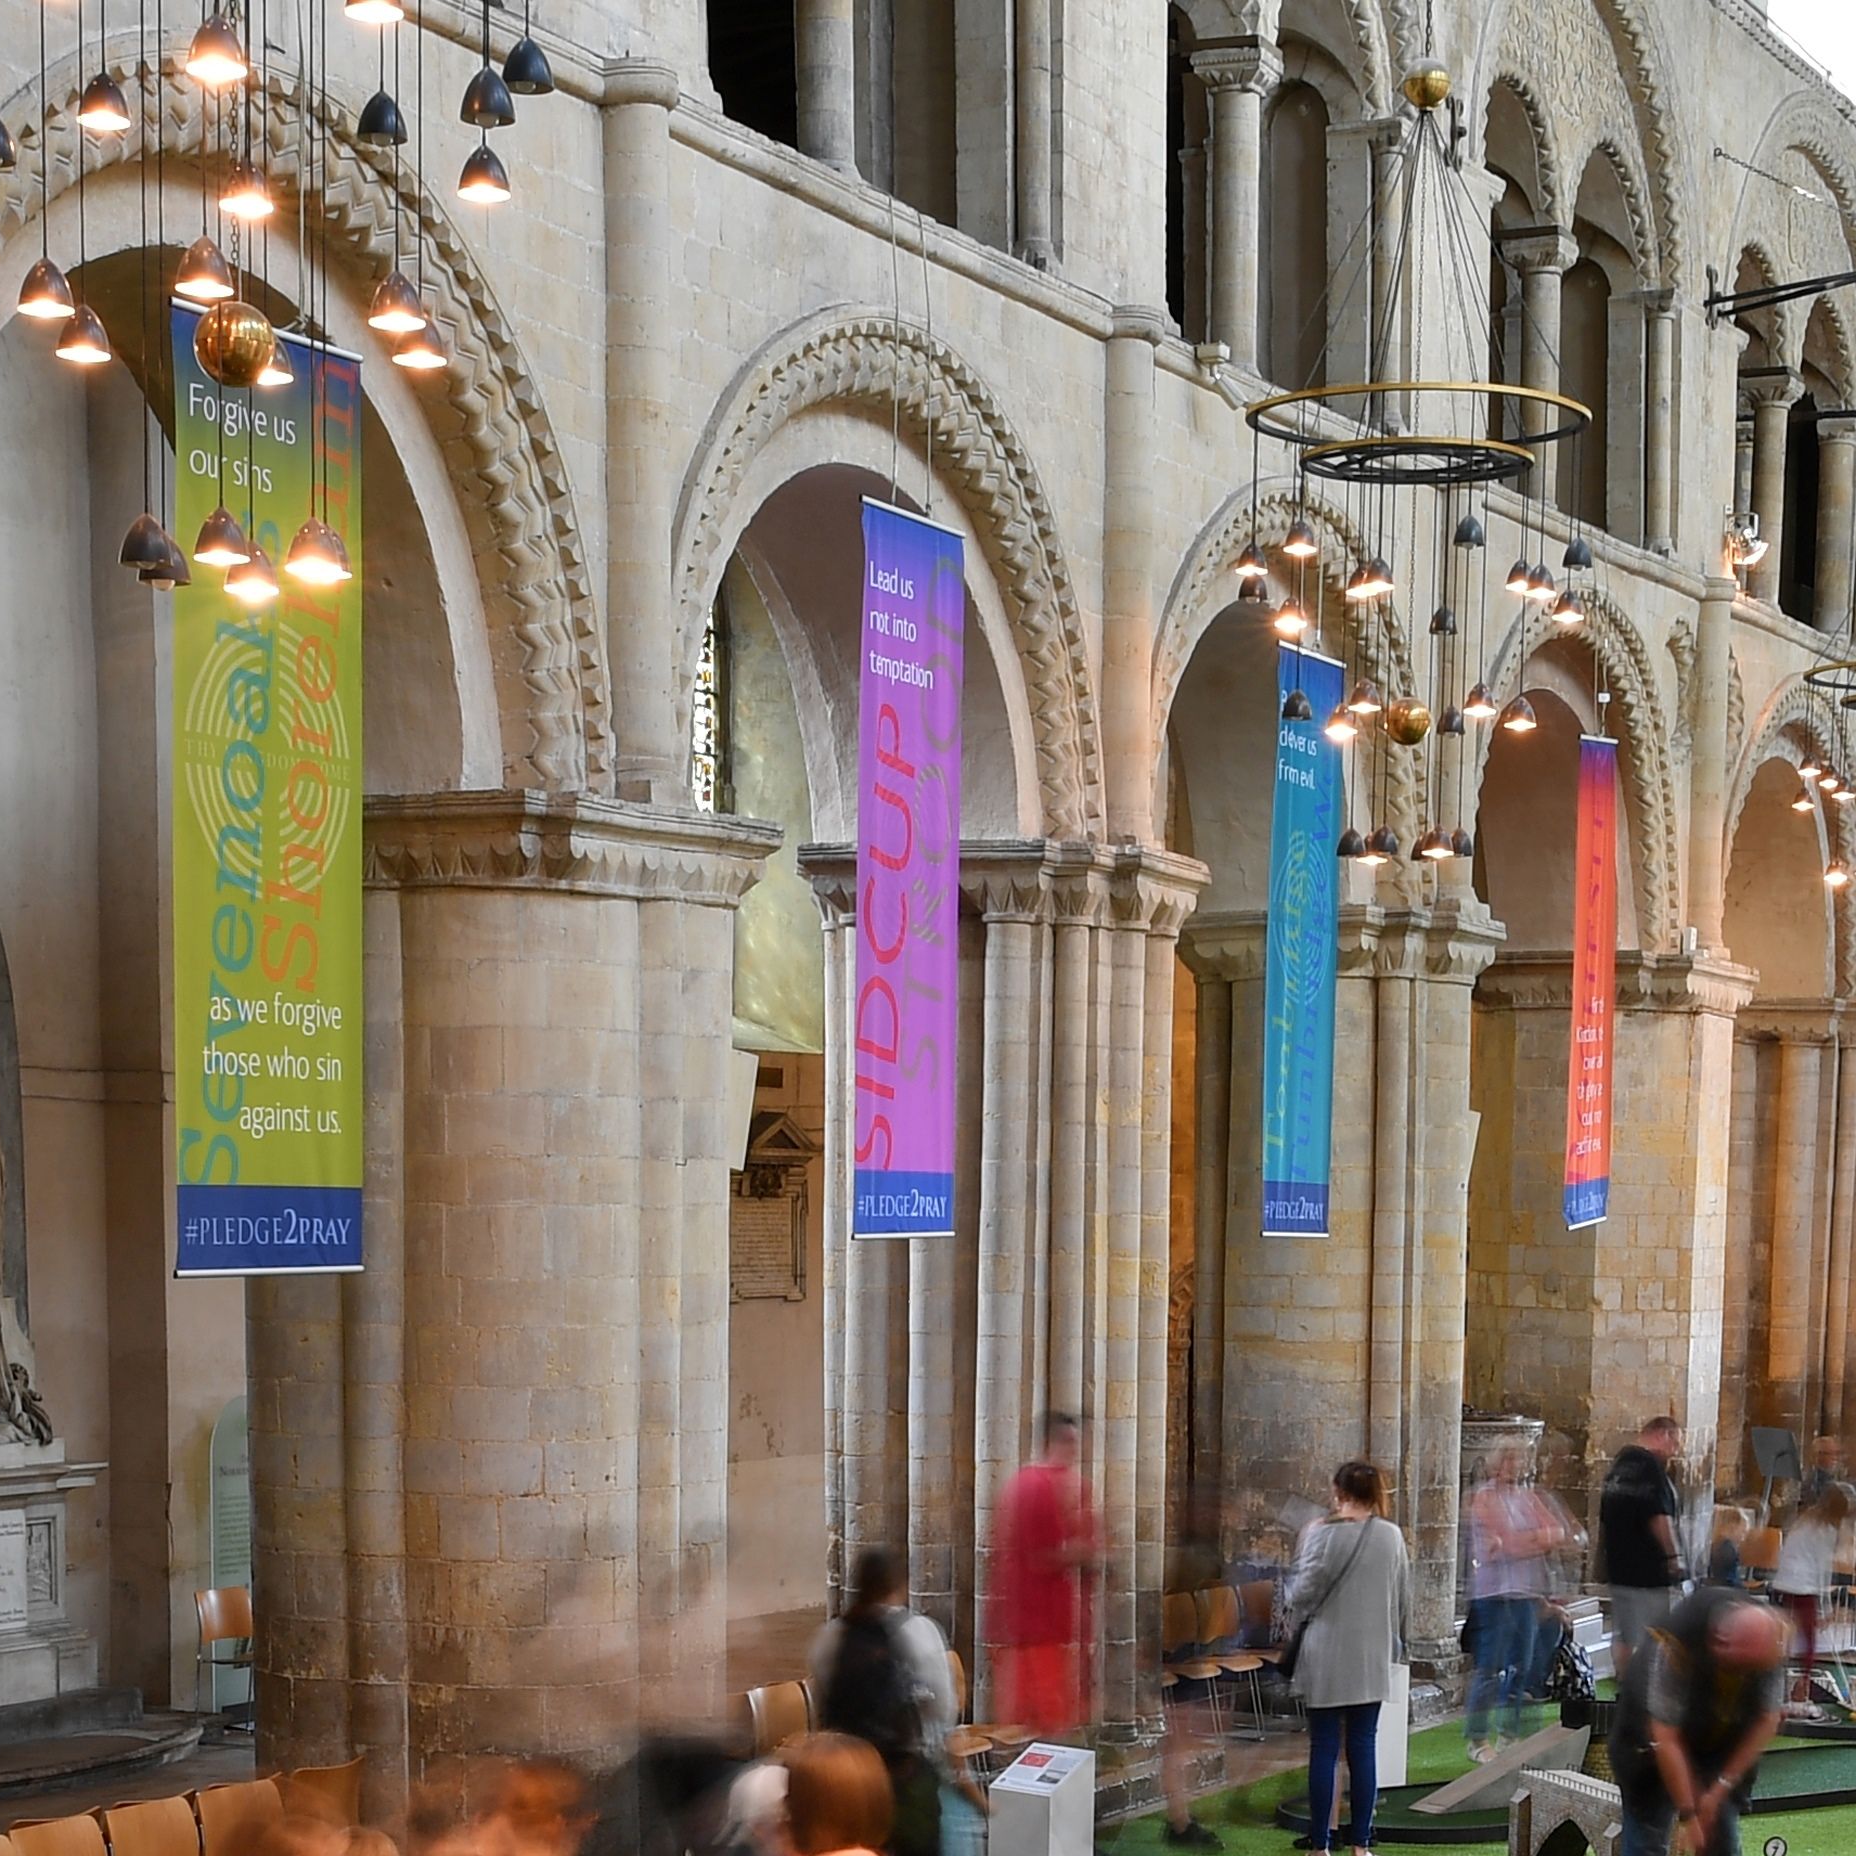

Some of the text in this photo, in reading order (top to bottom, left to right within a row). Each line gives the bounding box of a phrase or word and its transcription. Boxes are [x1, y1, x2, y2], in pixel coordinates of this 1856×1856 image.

[188, 382, 297, 446] Forgive us
[232, 454, 273, 495] sins
[869, 560, 915, 600] Lead us
[869, 609, 918, 643] not into
[869, 650, 934, 690] temptation
[900, 556, 965, 1092] STROOD
[854, 702, 917, 1171] SIDCUP
[209, 991, 343, 1037] as we forgive
[201, 1040, 343, 1082] those who sin
[239, 1101, 343, 1140] against us.
[857, 1187, 948, 1219] #PLEDGE2PRAY
[184, 1207, 352, 1246] #PLEDGE2PRAY
